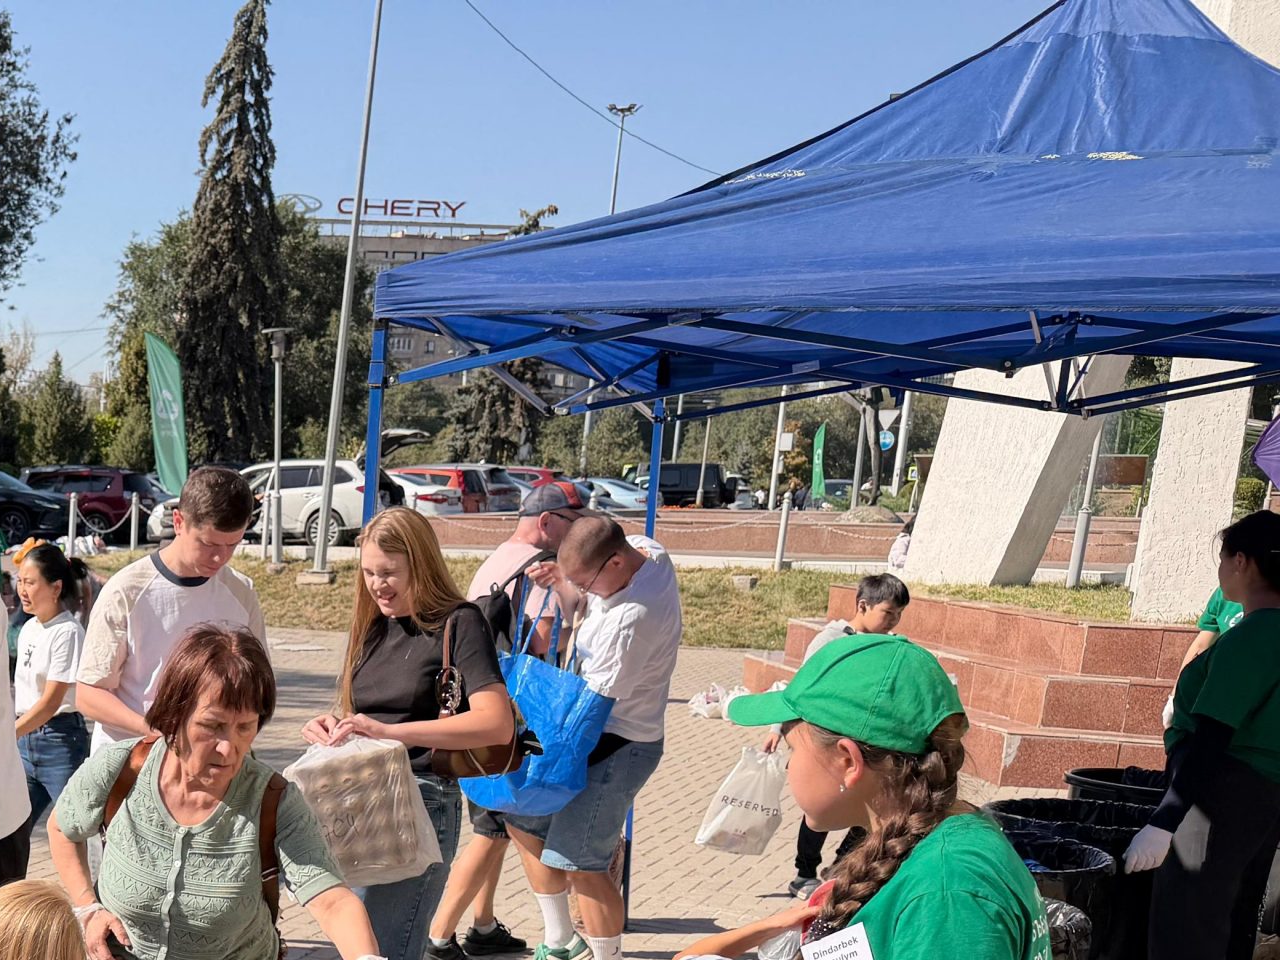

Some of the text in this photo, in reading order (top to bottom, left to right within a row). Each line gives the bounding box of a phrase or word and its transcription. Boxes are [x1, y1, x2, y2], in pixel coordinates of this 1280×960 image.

[337, 198, 466, 218] CHERY
[721, 795, 779, 817] RESERVED
[812, 936, 859, 960] Dindarbek
